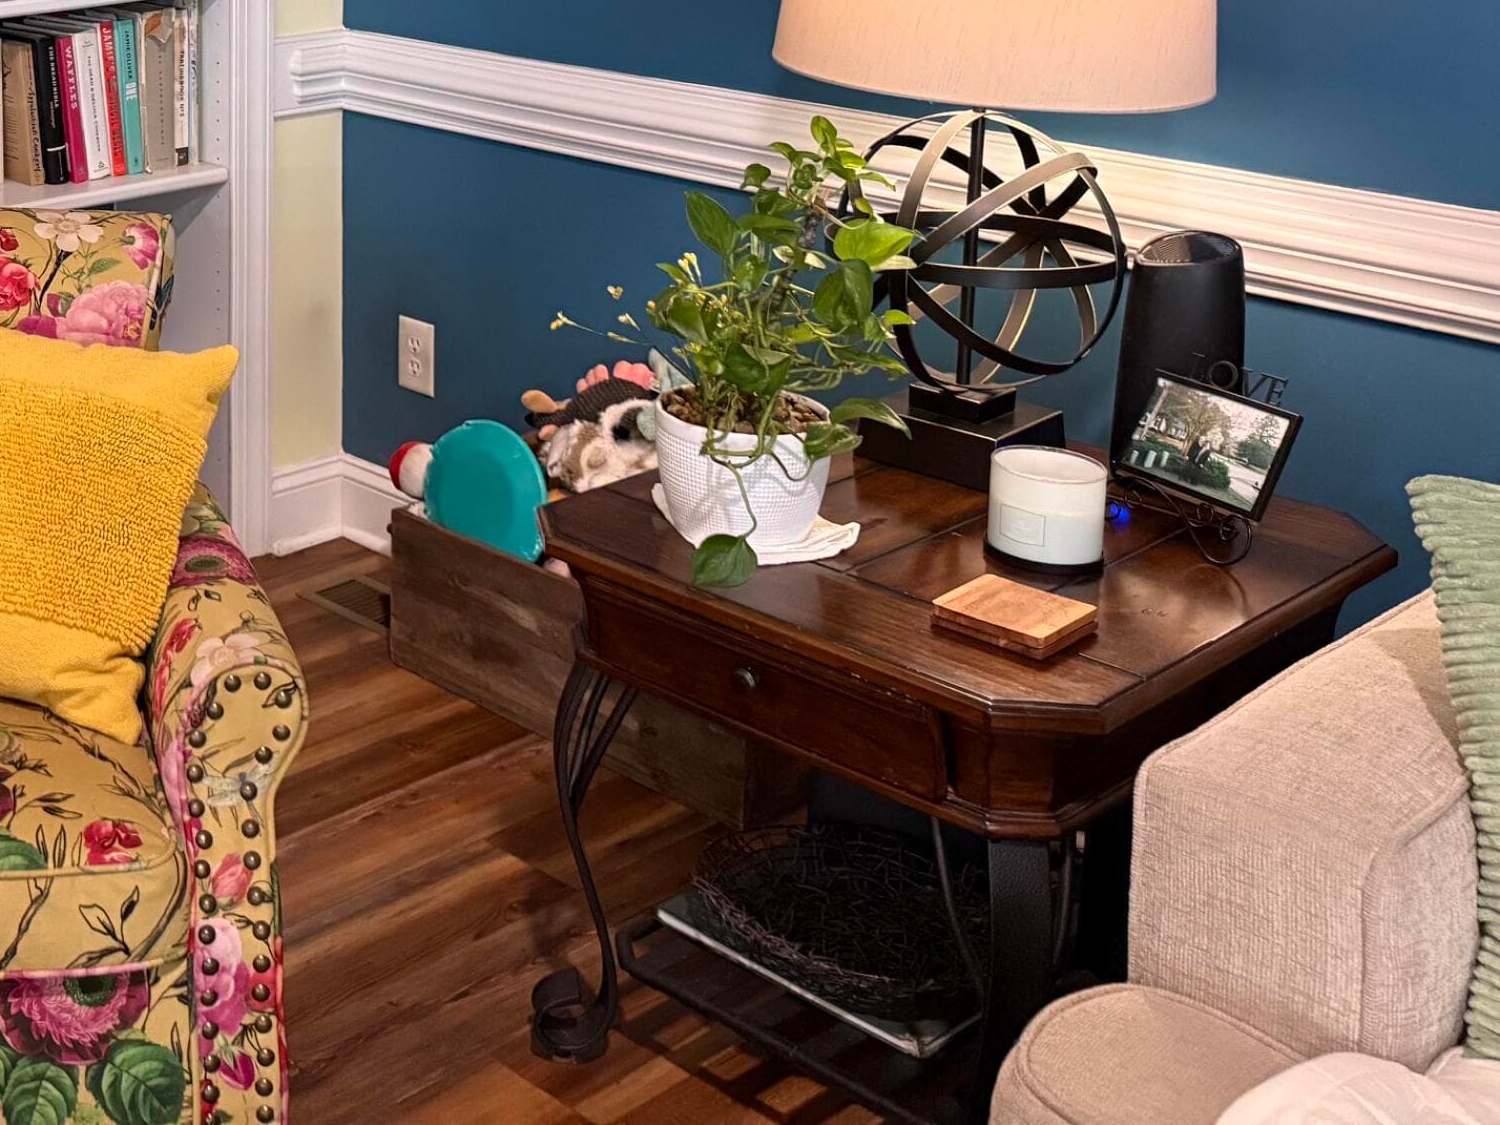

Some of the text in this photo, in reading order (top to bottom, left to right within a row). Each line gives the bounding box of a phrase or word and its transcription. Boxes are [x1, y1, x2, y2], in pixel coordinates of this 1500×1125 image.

[102, 27, 115, 72] JAMIE'S
[65, 45, 78, 110] WAFFLES
[126, 82, 138, 101] ONE
[31, 137, 42, 172] Cookery
